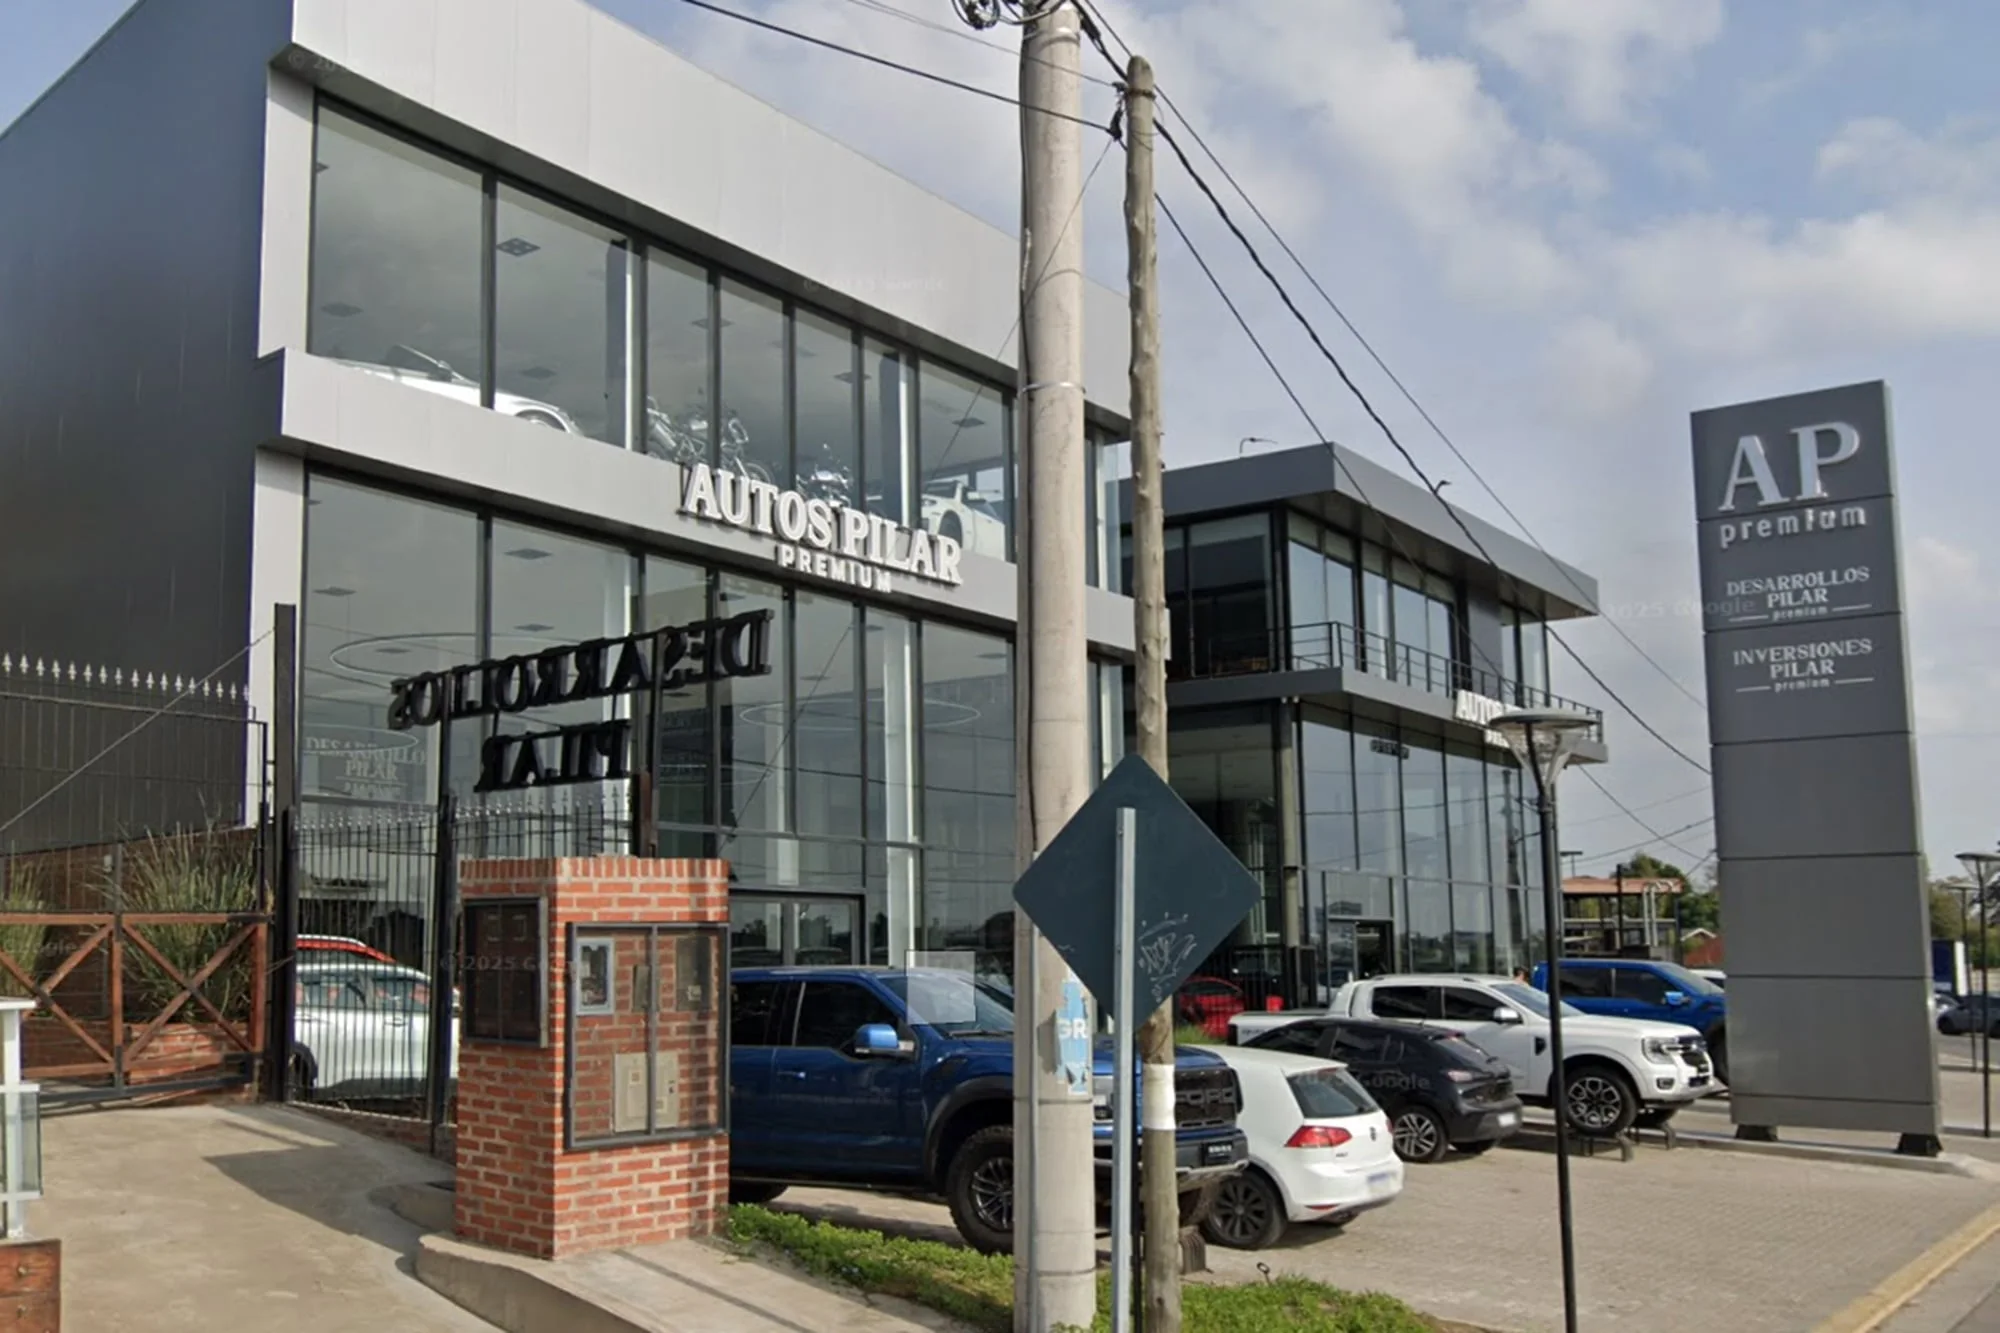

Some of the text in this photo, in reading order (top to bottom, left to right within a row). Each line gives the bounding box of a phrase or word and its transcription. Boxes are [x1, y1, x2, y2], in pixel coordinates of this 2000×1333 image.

[1718, 420, 1861, 513] AP
[679, 462, 963, 586] AUTOS PILAR
[1720, 505, 1867, 549] premium
[776, 544, 892, 593] PREMIUM
[1726, 565, 1871, 597] DESARROLLOS
[1767, 587, 1829, 609] PILAR
[1772, 604, 1829, 621] premium
[1733, 638, 1873, 666] INVERSIONES
[1769, 658, 1836, 680] PILAR
[1774, 677, 1831, 693] premium
